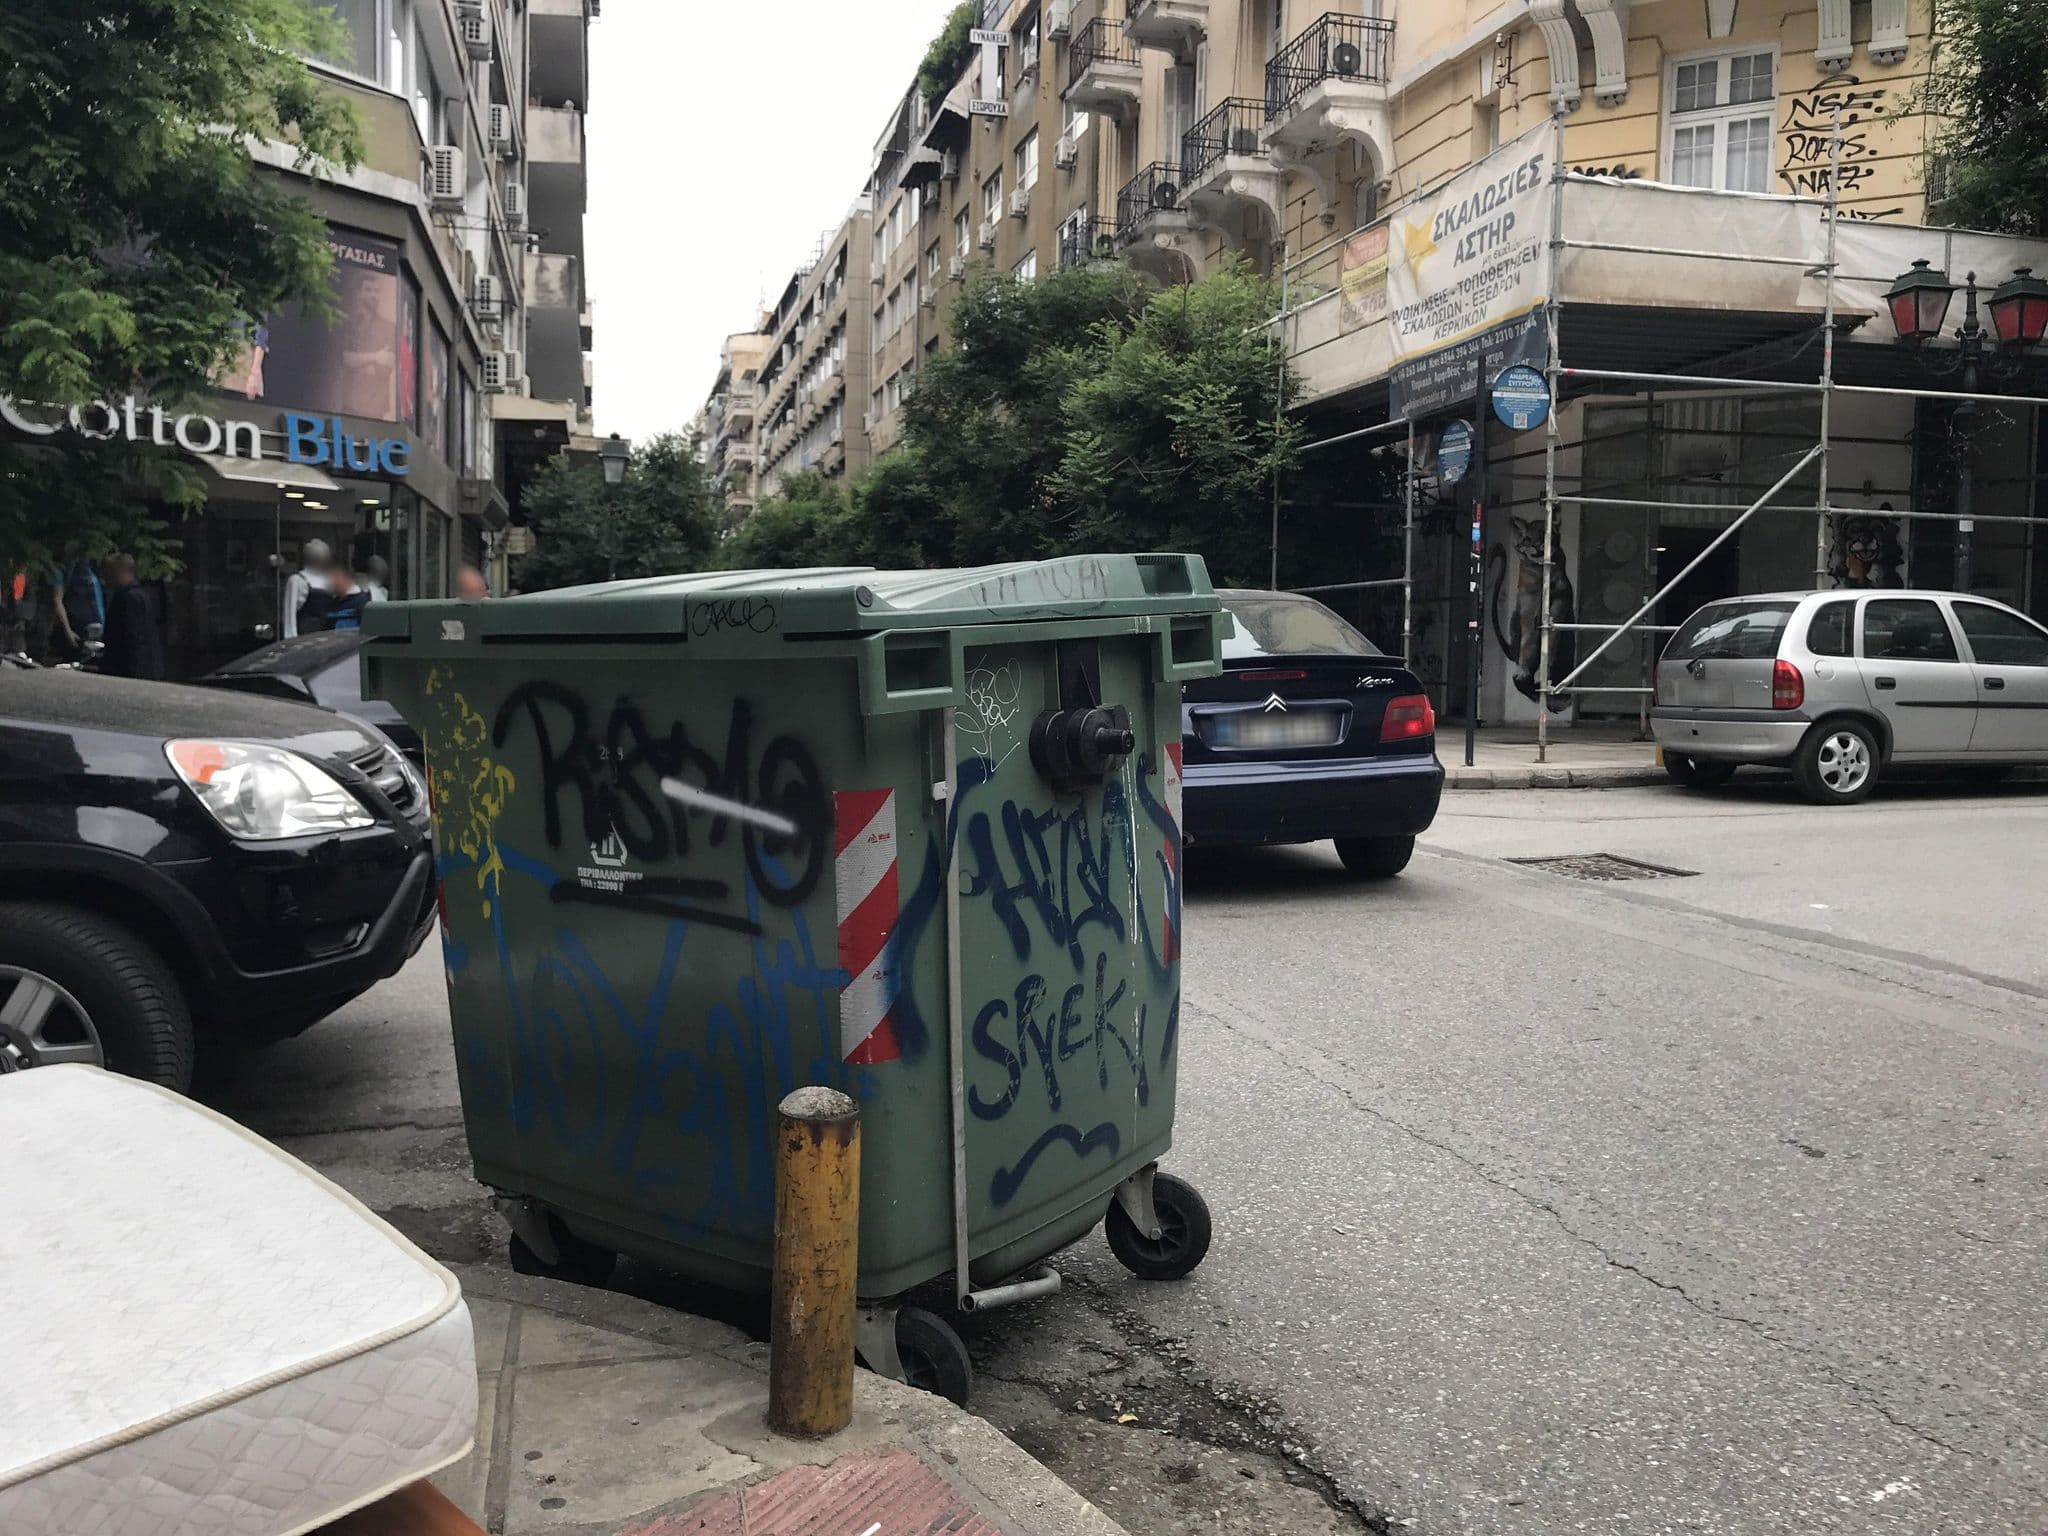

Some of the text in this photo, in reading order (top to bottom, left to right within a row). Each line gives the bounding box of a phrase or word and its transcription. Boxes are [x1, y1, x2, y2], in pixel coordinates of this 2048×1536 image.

[1433, 153, 1543, 242] ΣΚΑΛΩΣΙΕΣ
[1453, 211, 1515, 268] ΑΣΤΗΡ
[1401, 299, 1462, 336] ΣΚΑΛΩΣΙΩΝ
[1433, 305, 1487, 341] ΚΕΡΚΙΚΩΝ
[1495, 327, 1514, 344] 2310
[0, 394, 412, 475] Cotton Blue
